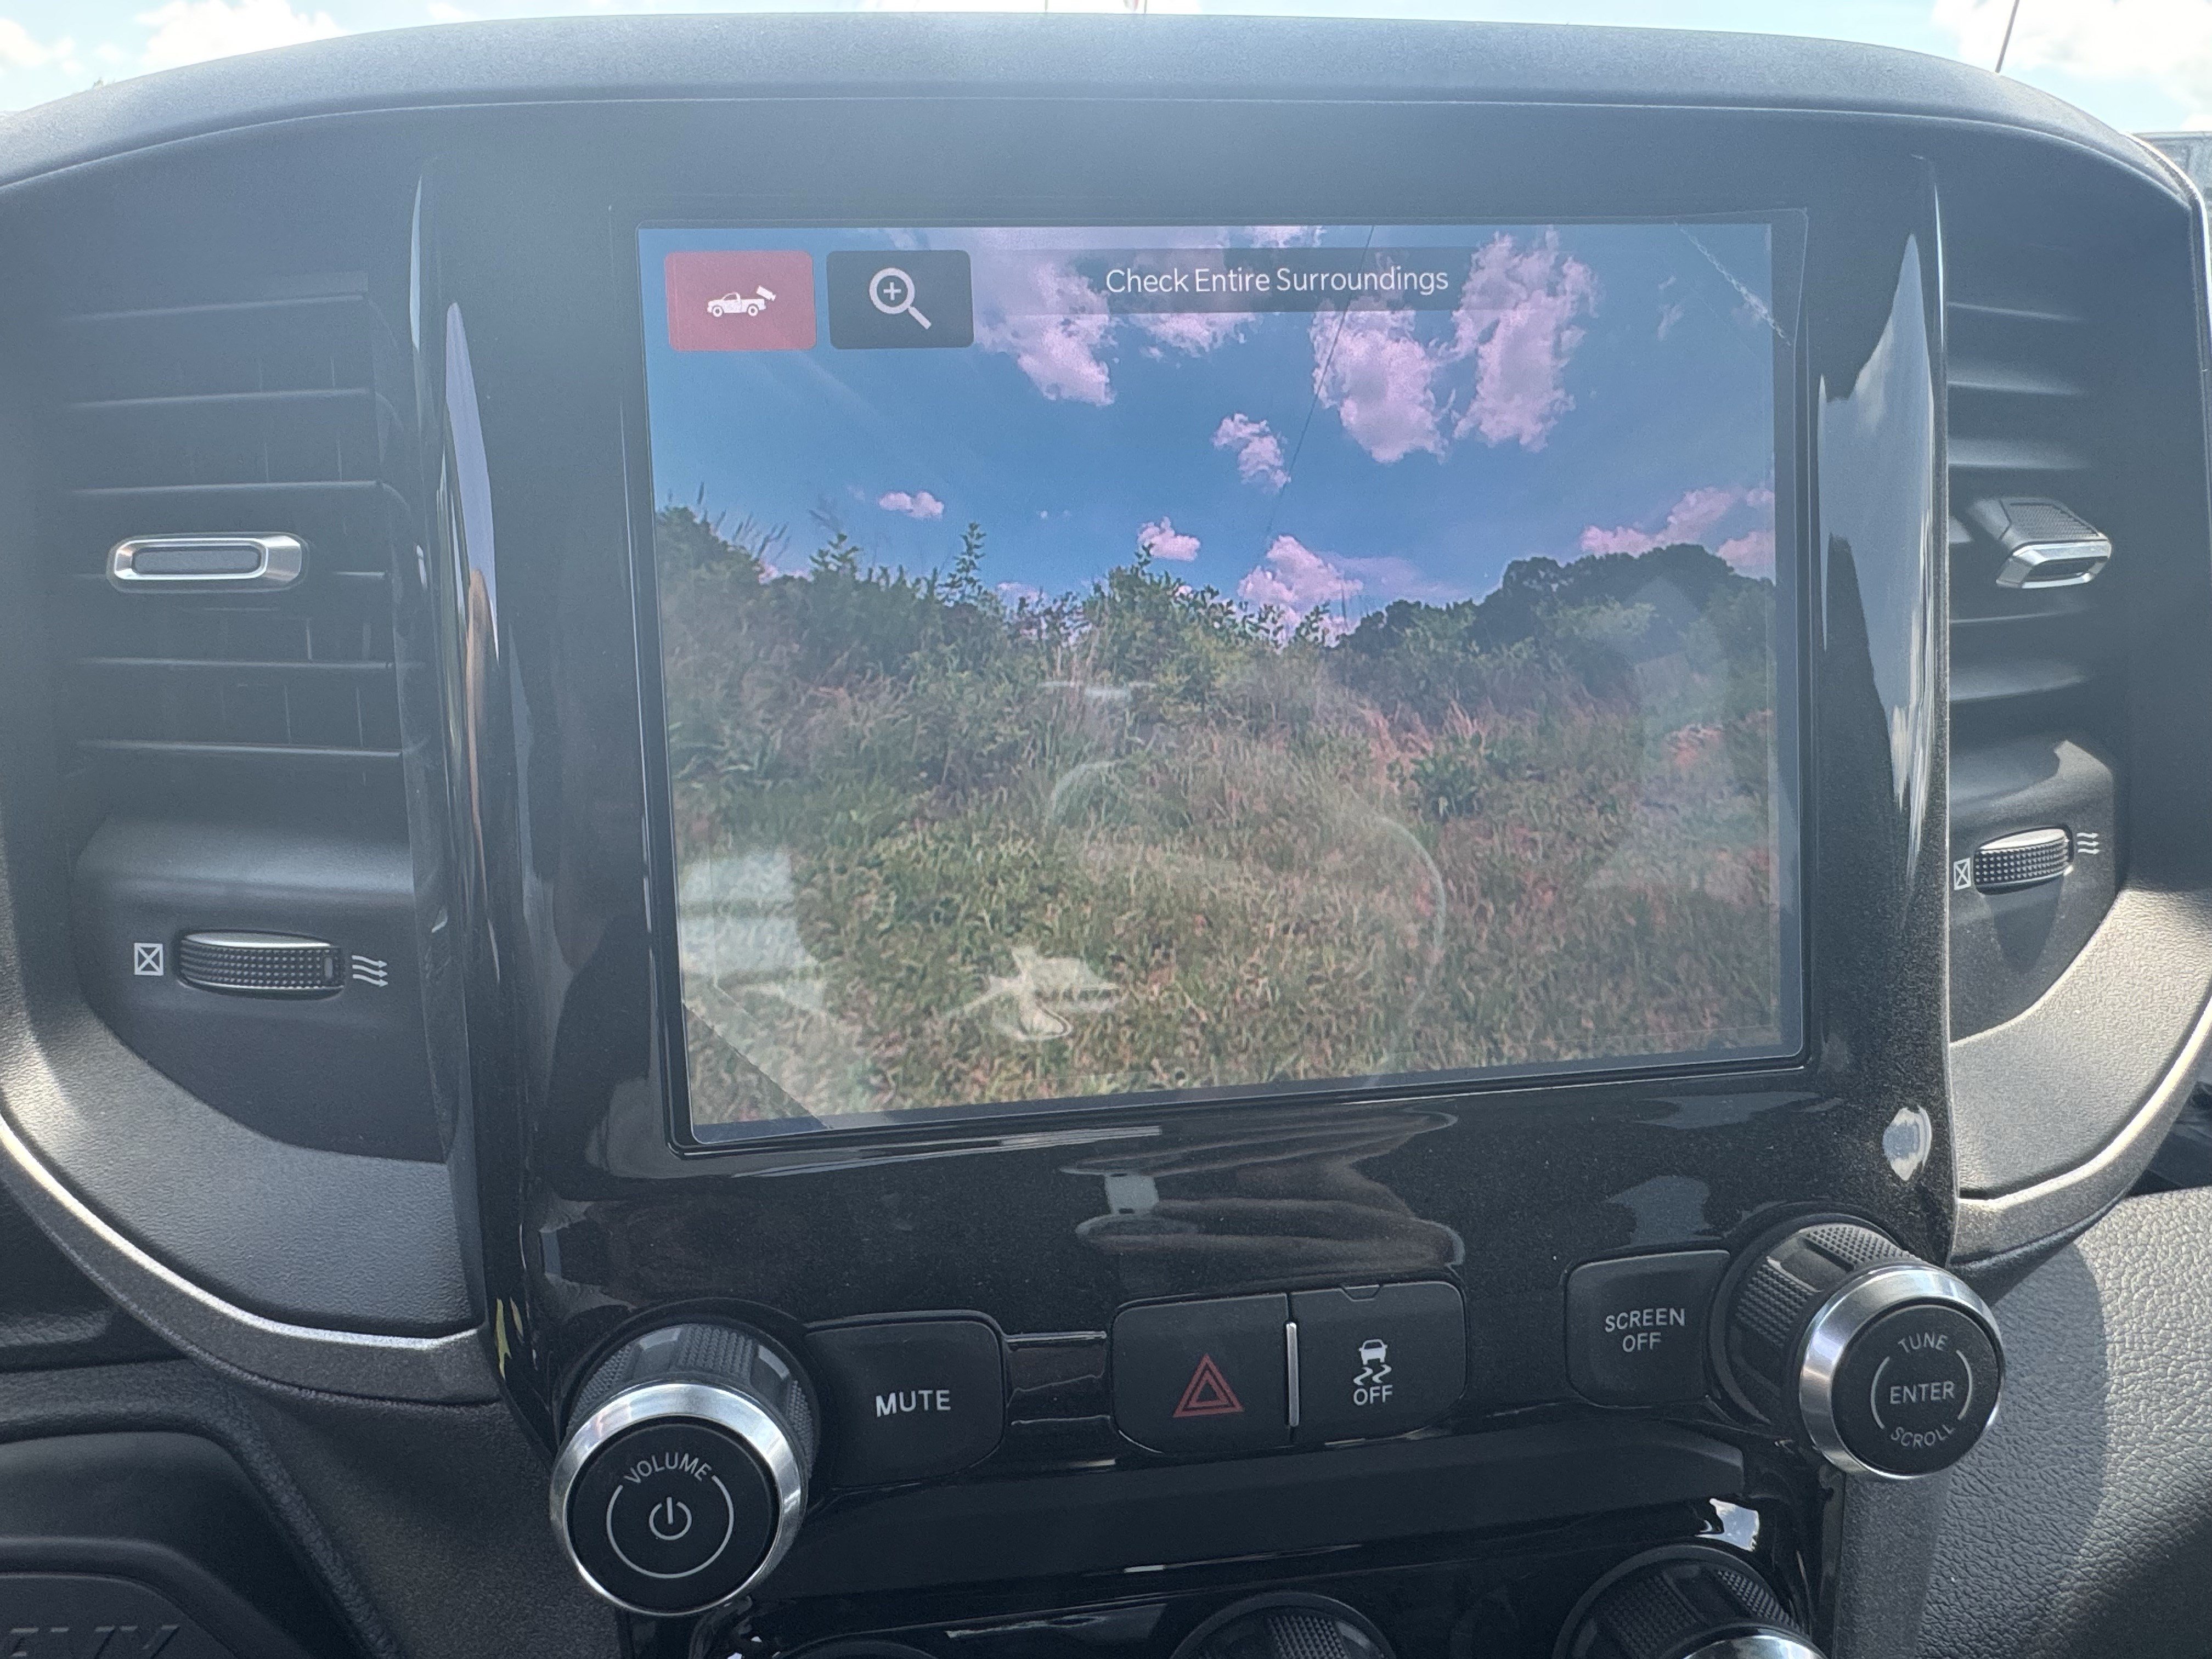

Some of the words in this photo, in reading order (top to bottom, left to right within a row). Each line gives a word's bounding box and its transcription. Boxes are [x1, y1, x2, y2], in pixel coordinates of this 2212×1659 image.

[1105, 268, 1189, 293] Check
[1195, 268, 1270, 292] Entire
[1276, 266, 1448, 295] Surroundings
[1605, 1307, 1686, 1333] SCREEN
[1622, 1331, 1662, 1353] OFF
[1897, 1331, 1948, 1354] TUNE
[876, 1389, 951, 1418] MUTE
[1353, 1384, 1393, 1406] OFF
[1889, 1380, 1956, 1404] ENTER
[1891, 1424, 1956, 1449] SCROLL
[623, 1452, 713, 1485] VOLUME
